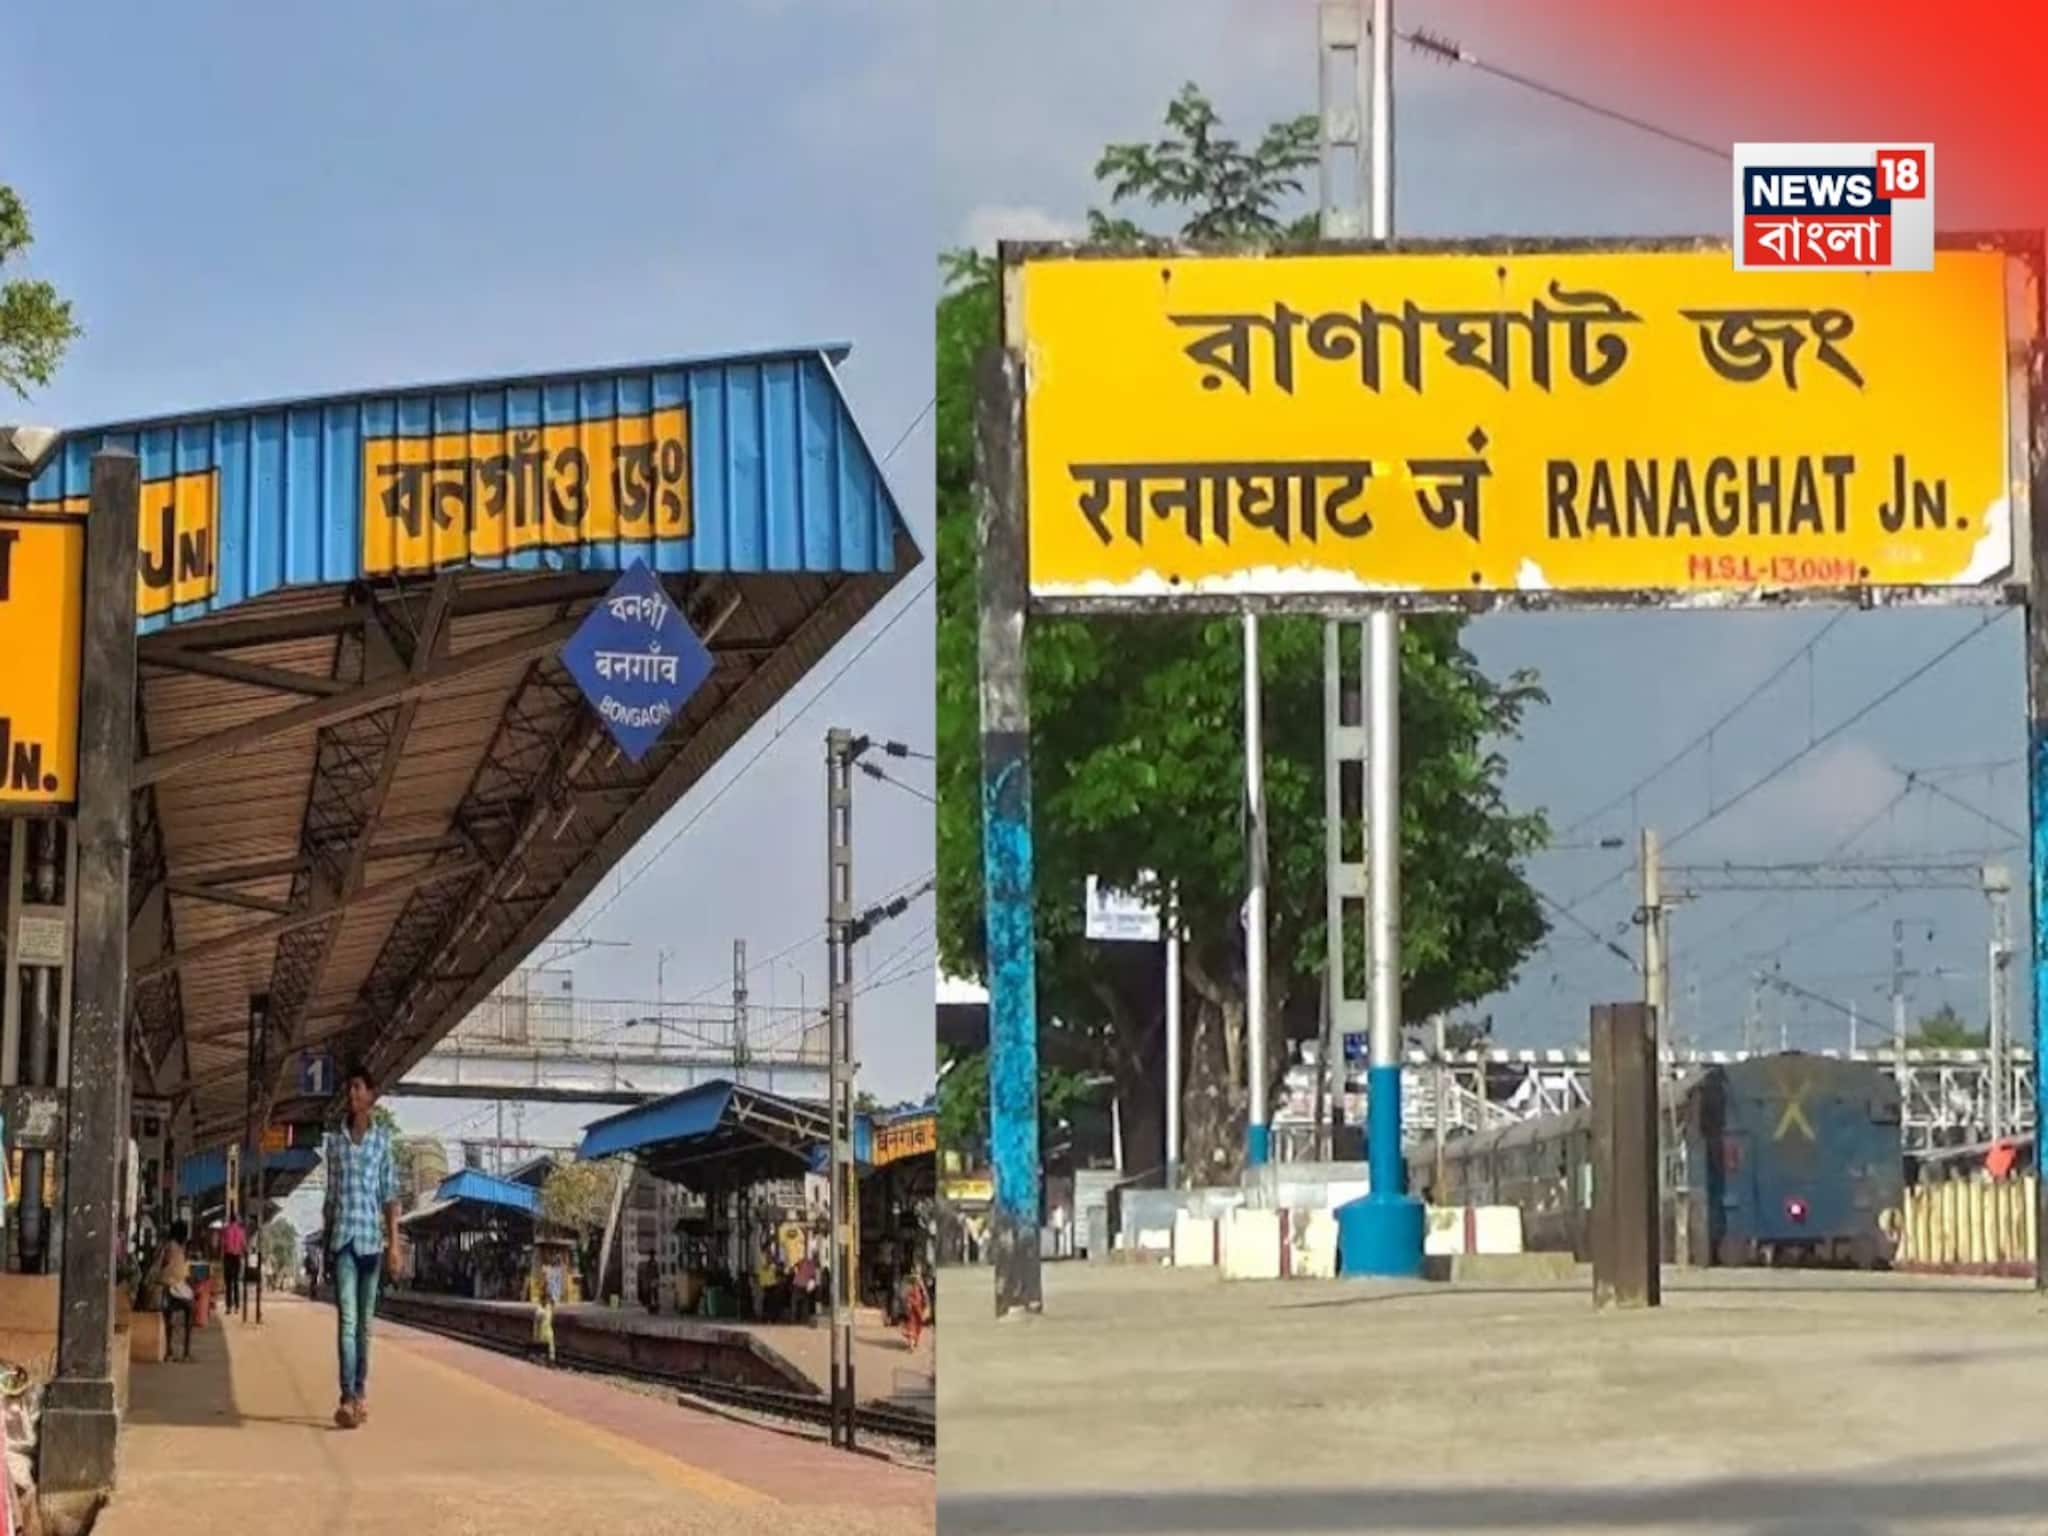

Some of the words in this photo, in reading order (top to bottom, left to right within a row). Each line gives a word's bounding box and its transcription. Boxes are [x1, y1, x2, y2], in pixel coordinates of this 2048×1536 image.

[1167, 280, 1645, 395] রাণাঘাট
[1678, 309, 1865, 392] জং
[377, 431, 589, 538] বনগাঁও
[611, 441, 683, 525] জং
[1068, 461, 1374, 546] रानाघाट
[1405, 426, 1492, 543] जं
[1546, 455, 1855, 539] RANAGHAT
[600, 695, 672, 727] BONGAON
[307, 1059, 323, 1092] 1
